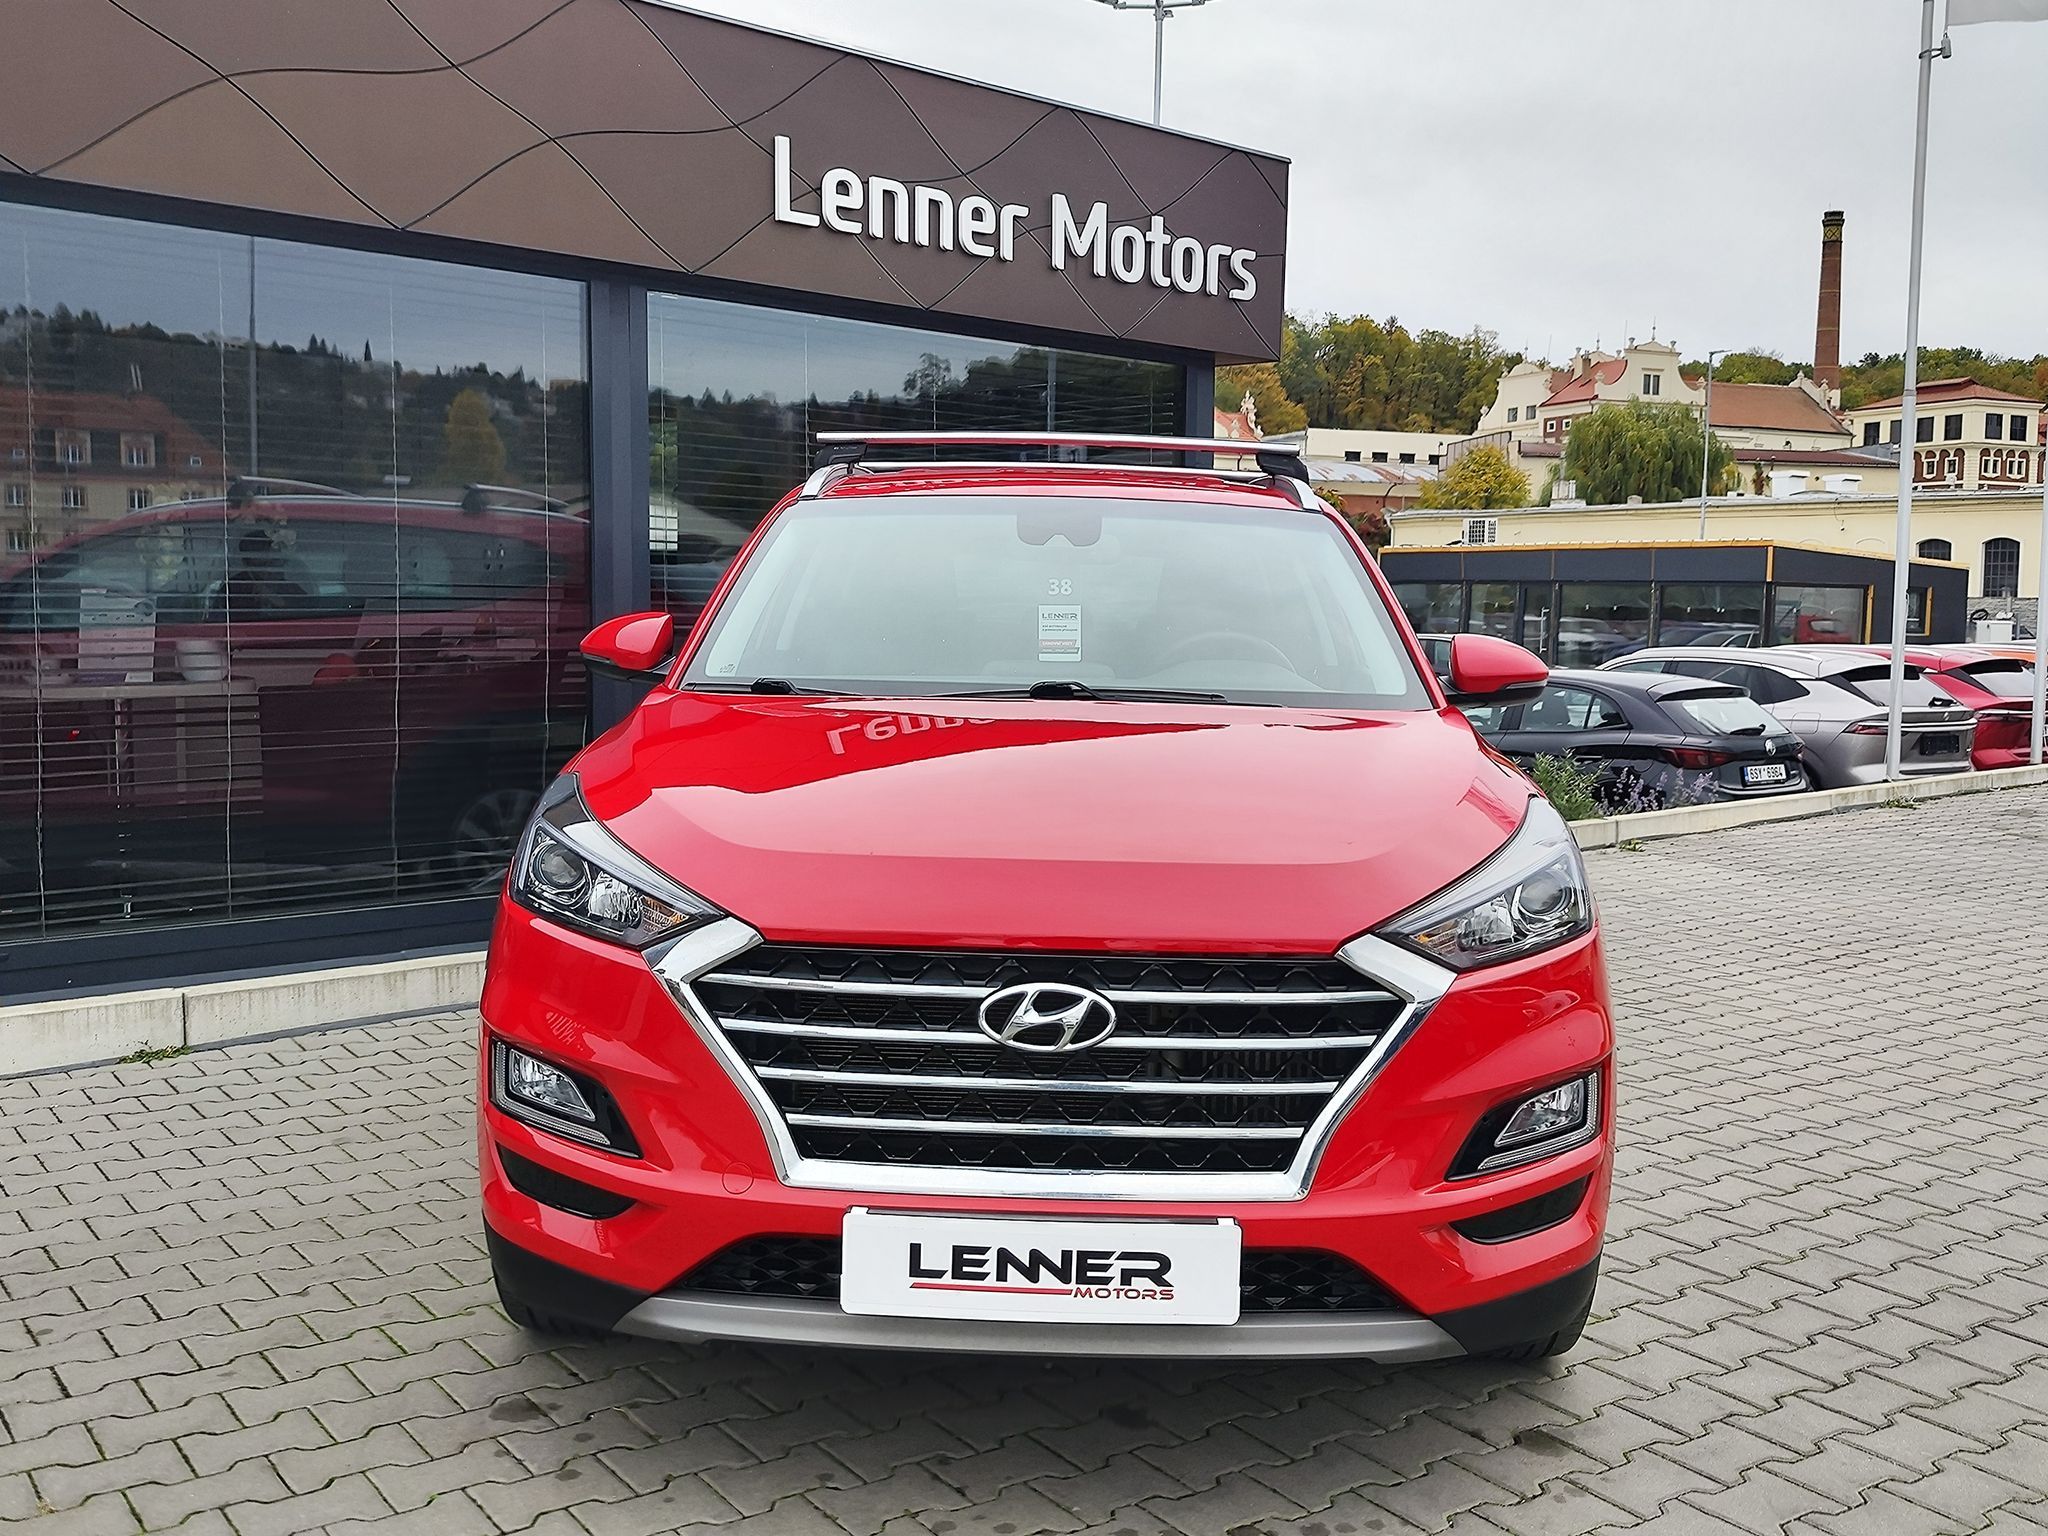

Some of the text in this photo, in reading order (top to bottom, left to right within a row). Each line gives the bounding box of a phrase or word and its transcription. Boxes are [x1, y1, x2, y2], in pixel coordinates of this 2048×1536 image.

[773, 135, 1257, 301] Lenner Motors
[1048, 578, 1073, 596] 38
[908, 1242, 1175, 1288] LENNER
[1072, 1287, 1175, 1301] MOTORS
